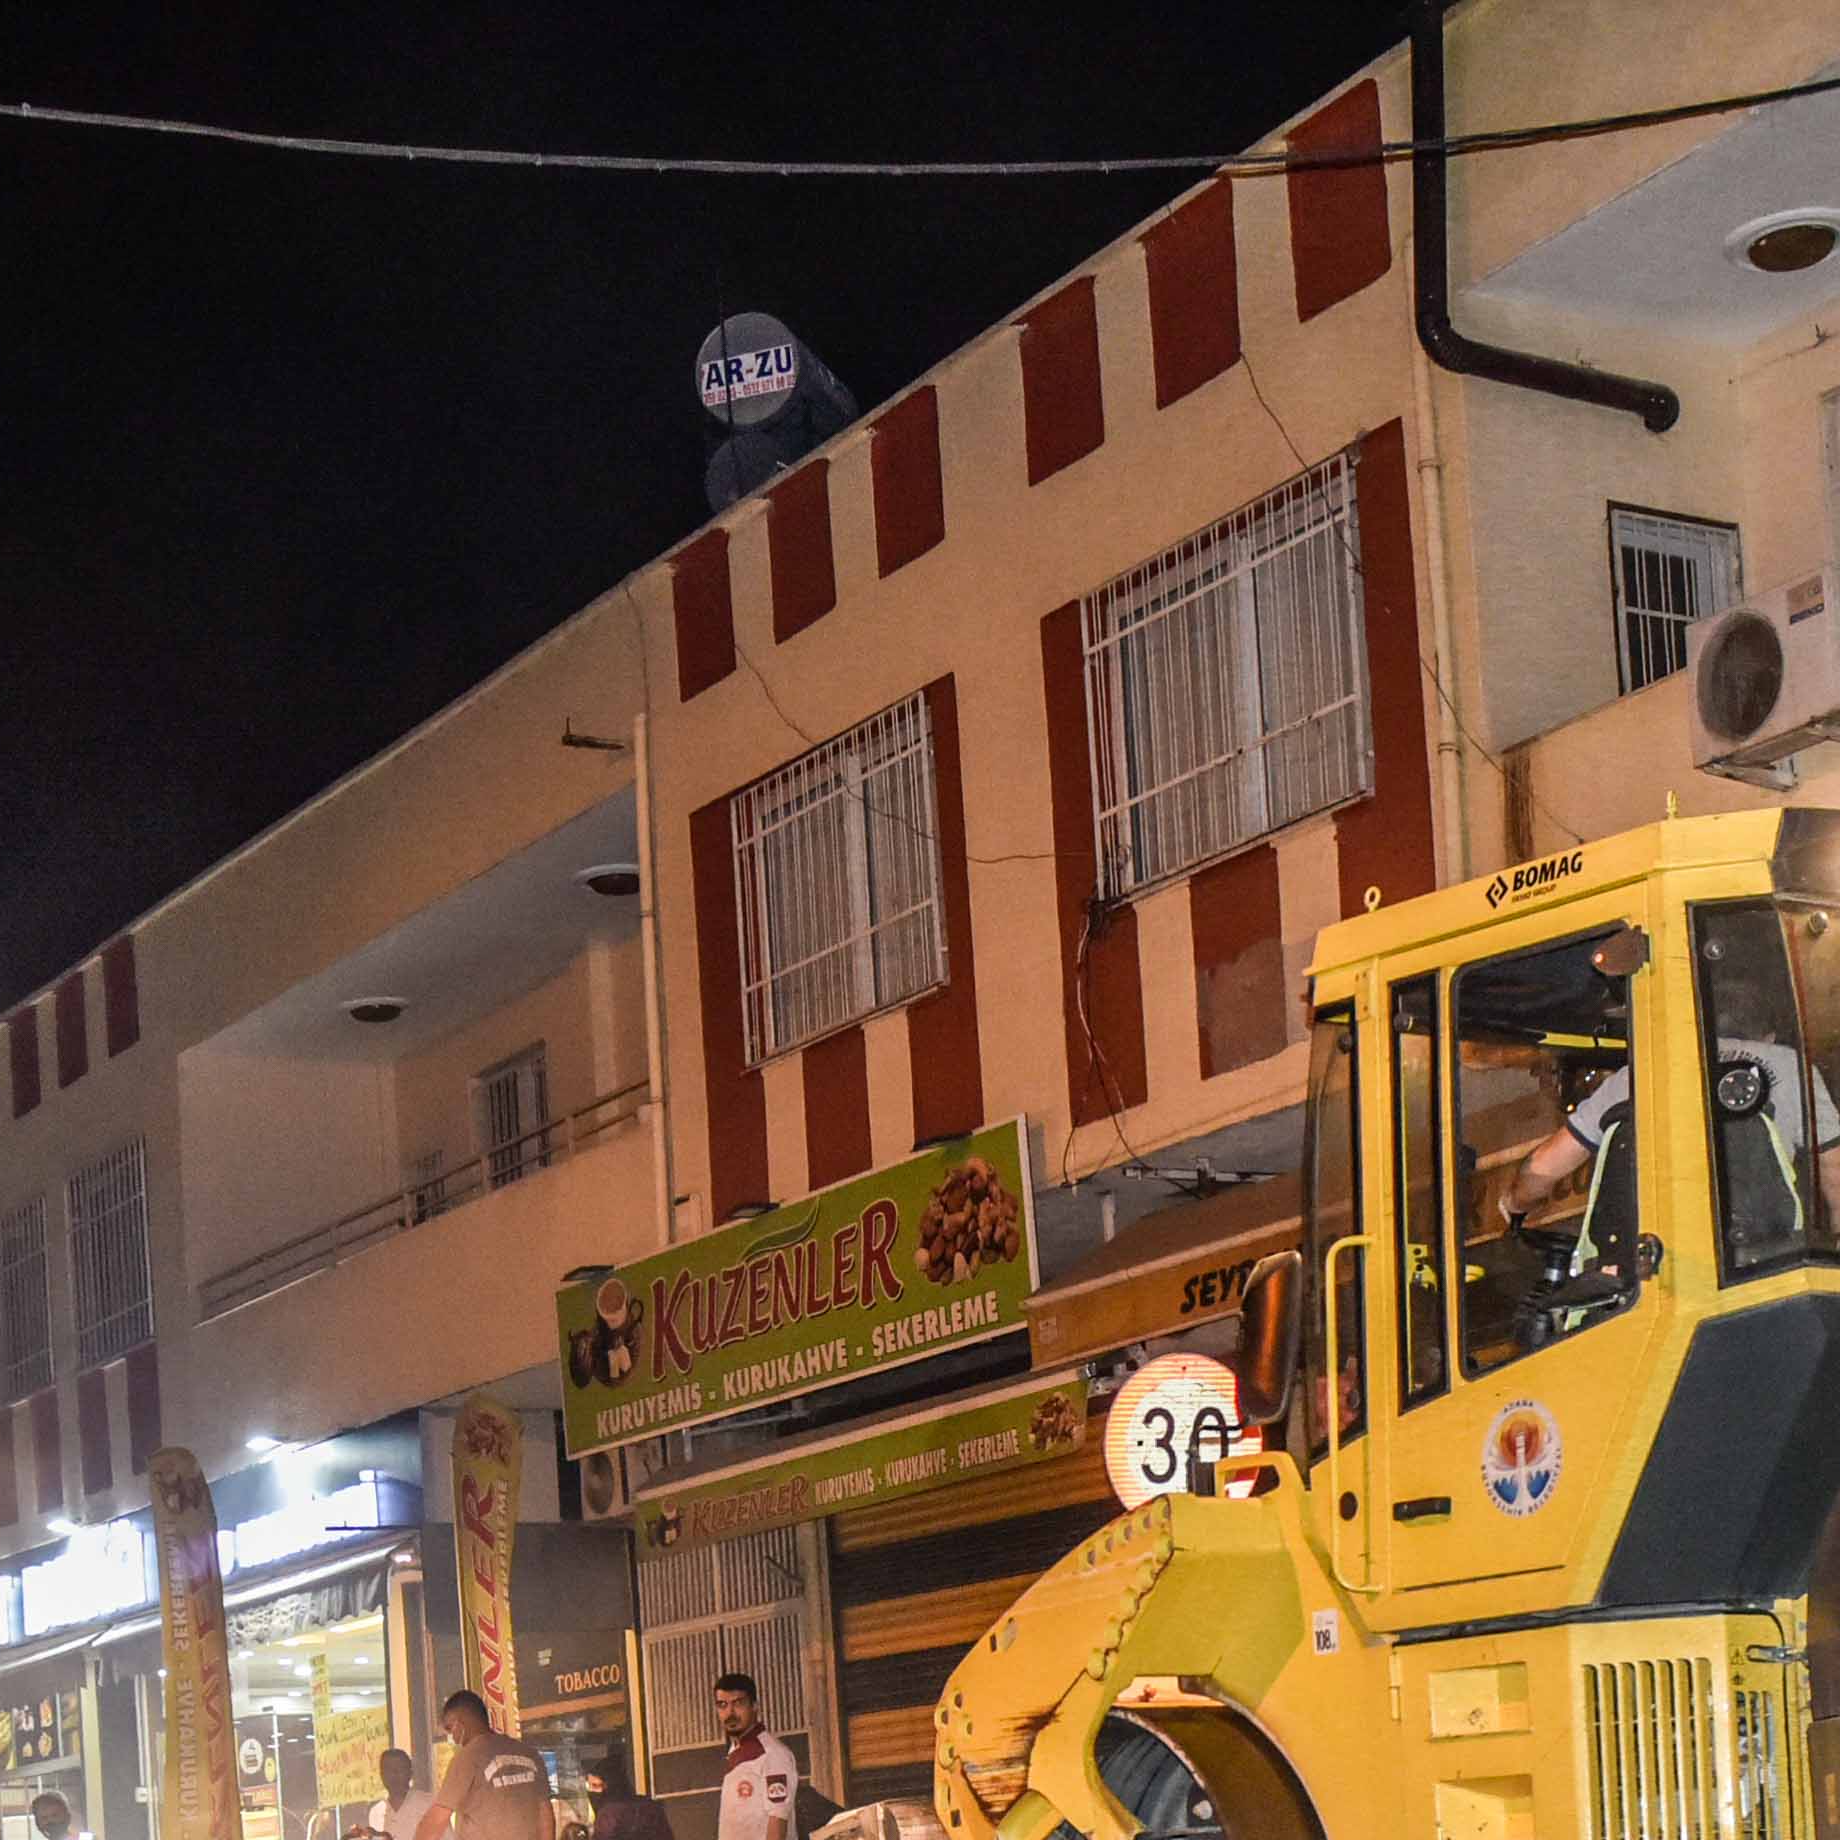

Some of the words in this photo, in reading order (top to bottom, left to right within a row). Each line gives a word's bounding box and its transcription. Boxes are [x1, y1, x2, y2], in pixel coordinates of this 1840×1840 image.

[1512, 851, 1584, 892] BOMAG
[650, 1198, 904, 1383] KUZENLER
[722, 1336, 849, 1402] KURUKAHVE
[871, 1290, 999, 1361] ŞEKERLEME
[1141, 1406, 1228, 1484] 30
[463, 1475, 506, 1733] ENLER
[1315, 1629, 1332, 1652] 108
[555, 1664, 620, 1695] TOBACCO
